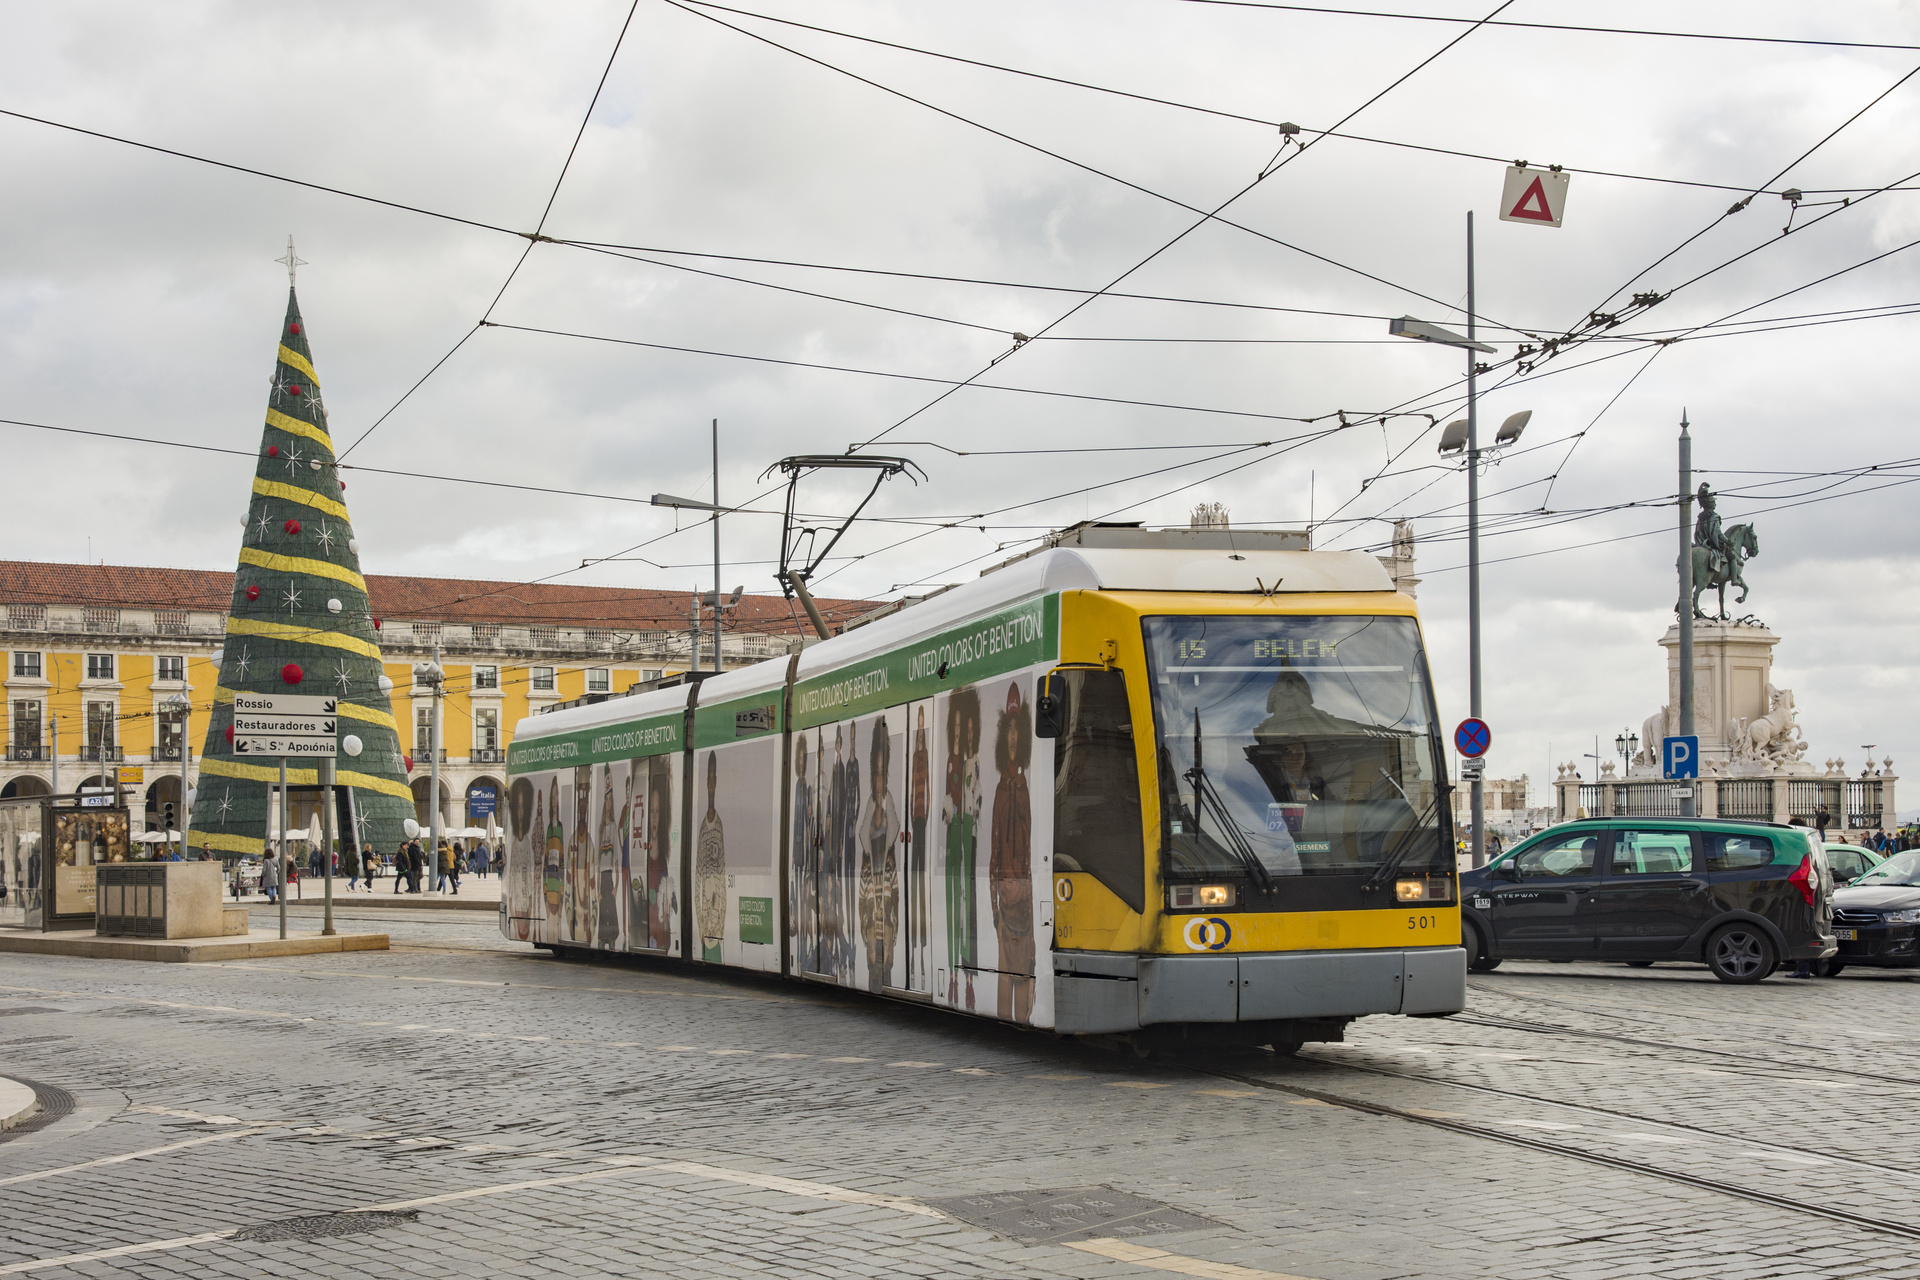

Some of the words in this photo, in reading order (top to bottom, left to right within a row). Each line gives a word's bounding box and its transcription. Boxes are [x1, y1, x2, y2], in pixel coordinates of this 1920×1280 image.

[908, 650, 937, 681] UNITED
[938, 635, 973, 672] COLORS
[975, 630, 988, 658] OF
[1180, 640, 1206, 659] 15
[1254, 639, 1338, 658] BELEM
[236, 698, 273, 709] Rossio
[799, 690, 820, 714] UNITED
[820, 682, 843, 709] COLORS
[843, 678, 853, 702] OF
[236, 719, 316, 731] Restauradores
[288, 741, 335, 753] Apolónia
[591, 737, 612, 754] UNITED
[611, 732, 635, 750] COLORS
[635, 730, 644, 747] OF
[511, 749, 528, 766] UNITED
[528, 746, 546, 763] COLORS
[546, 745, 553, 761] OF
[1671, 741, 1690, 775] P
[1295, 843, 1329, 851] SIEMENS
[1408, 916, 1436, 930] 501
